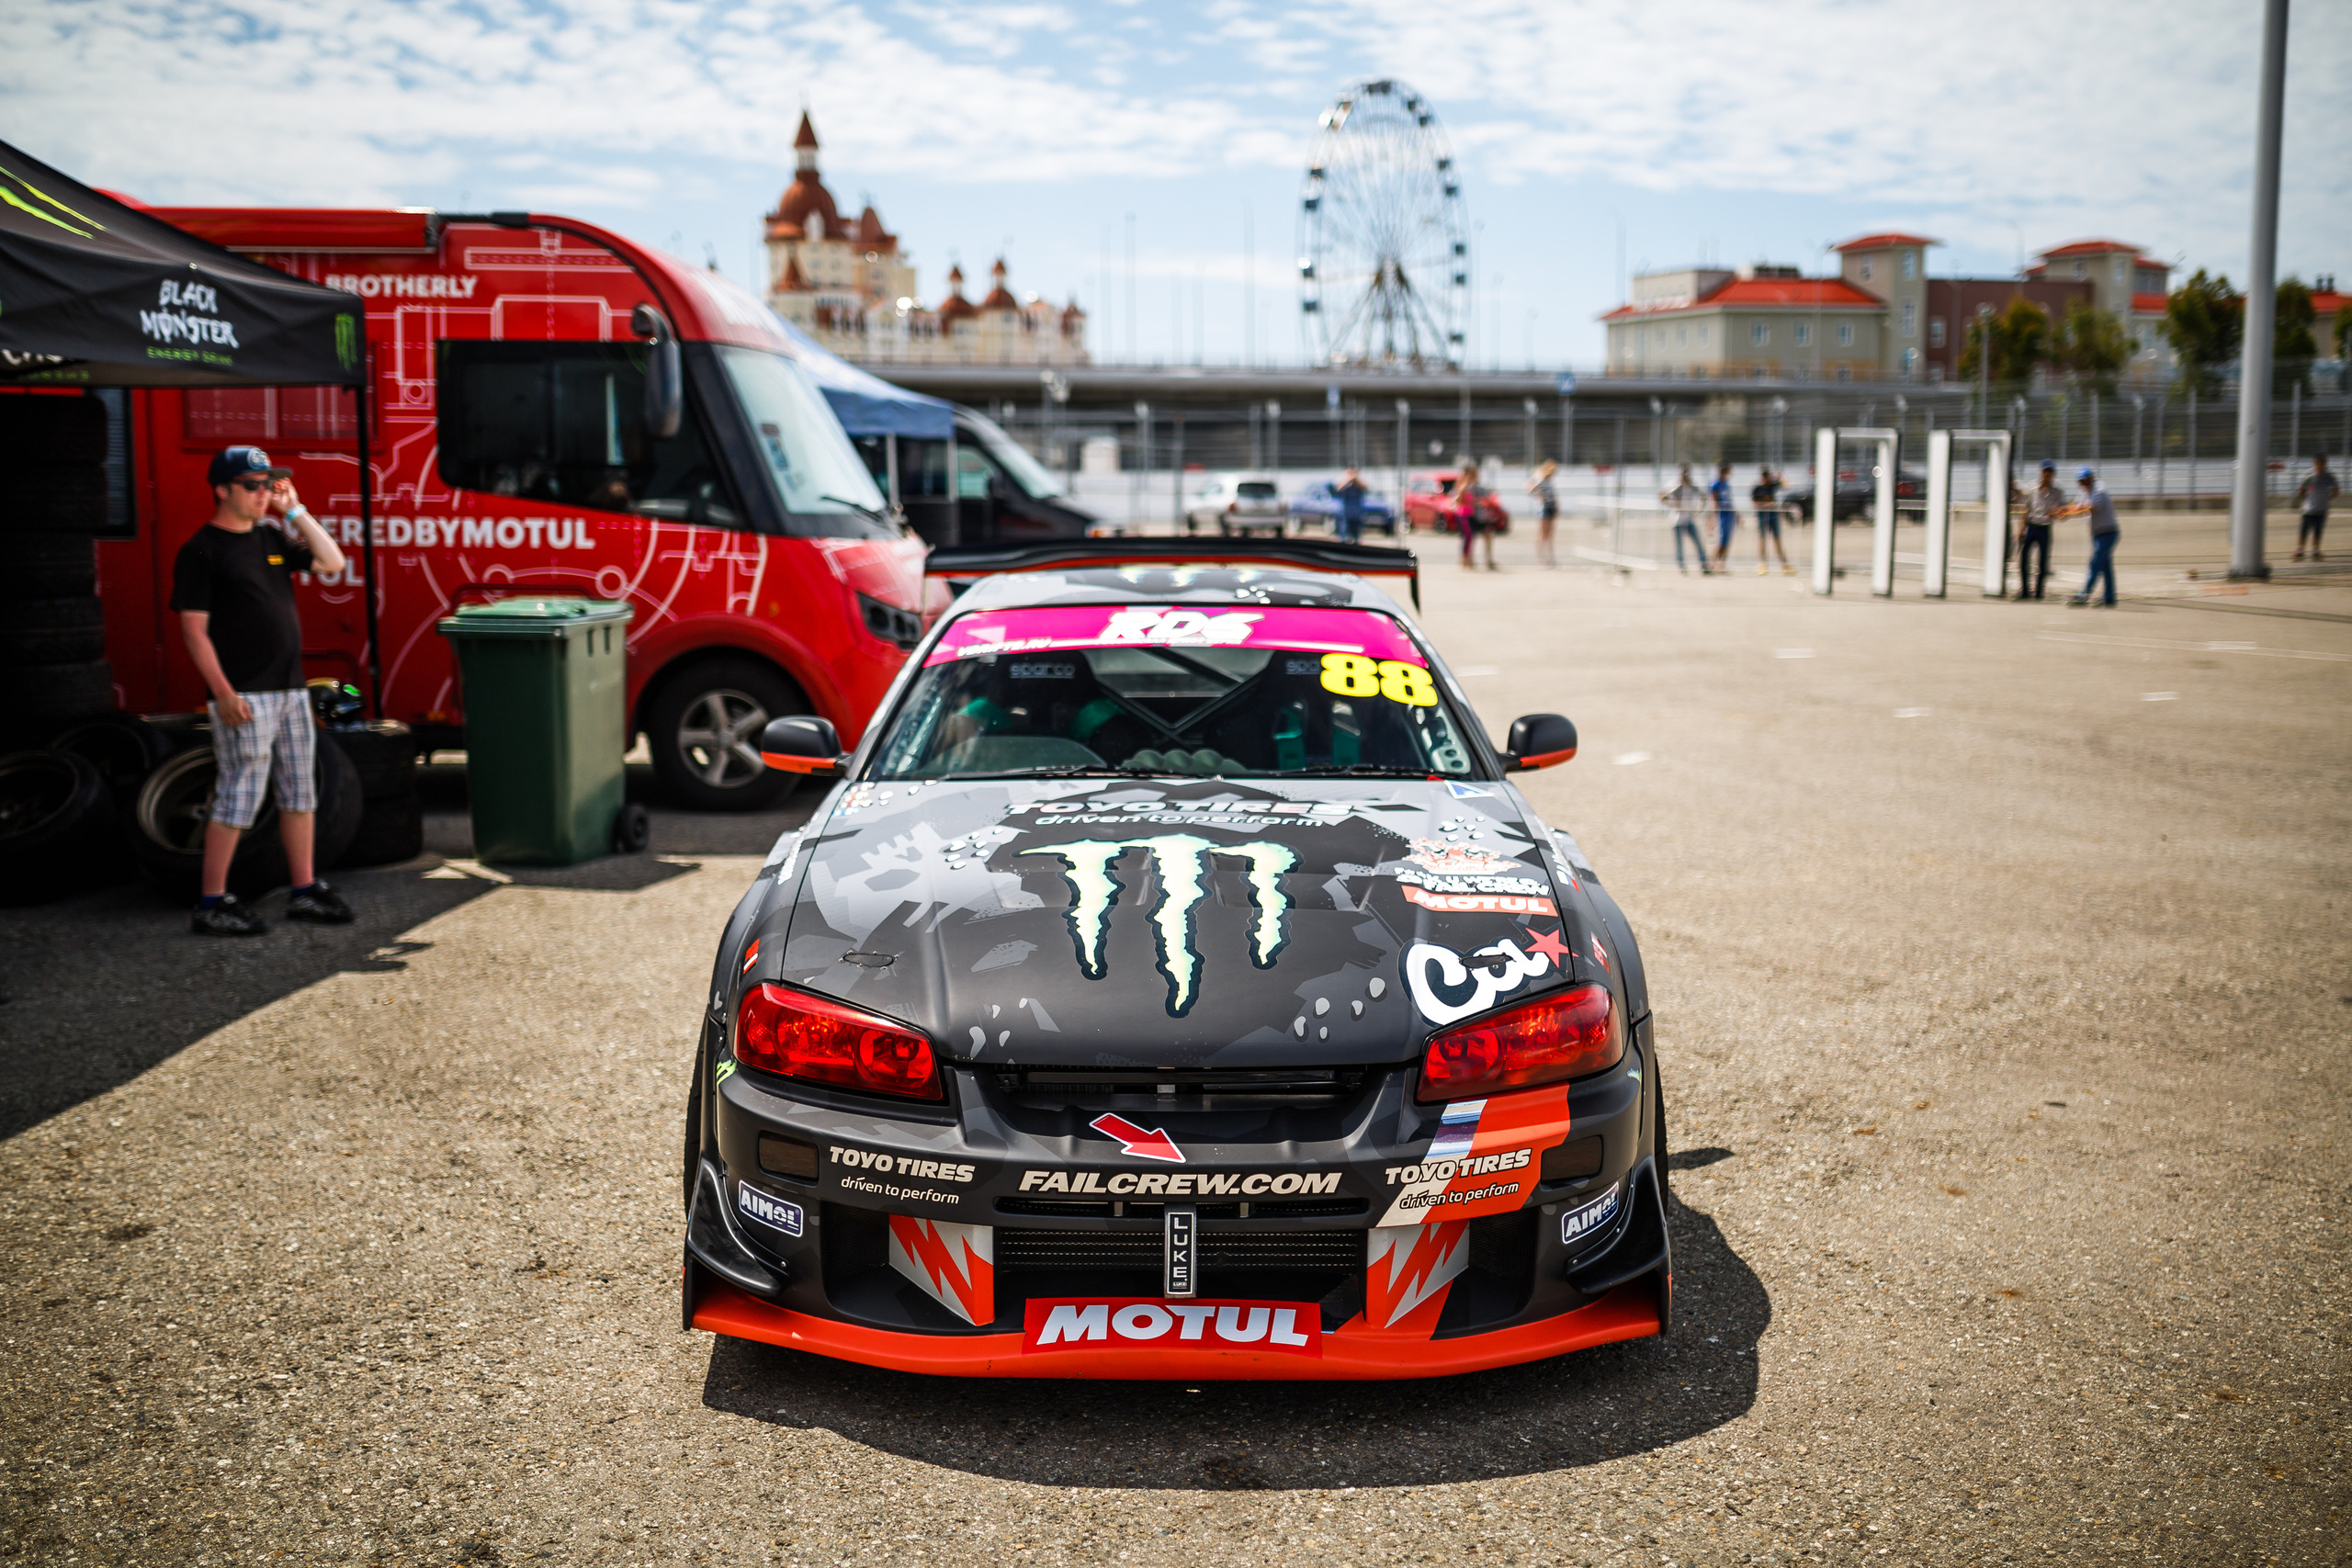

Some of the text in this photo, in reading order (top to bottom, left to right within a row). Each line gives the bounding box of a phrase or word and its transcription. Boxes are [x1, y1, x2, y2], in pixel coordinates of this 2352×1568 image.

[158, 278, 218, 313] BLACK
[324, 274, 478, 299] BROTHERLY
[139, 306, 240, 349] MONSTER
[1011, 662, 1075, 678] sparco
[1285, 659, 1320, 675] spa
[1319, 652, 1439, 707] 88
[1008, 800, 1353, 817] TOYO TIRES
[1035, 813, 1324, 828] driven to perform
[1413, 889, 1549, 914] MOTUL
[830, 1145, 976, 1183] TOYO TIRES
[1384, 1147, 1532, 1186] TOYO TIRES
[841, 1176, 960, 1205] driven to perform
[1018, 1170, 1342, 1195] FAILCREW.COM
[1398, 1181, 1520, 1210] driven to perform
[741, 1189, 799, 1231] AIMOL
[1172, 1216, 1189, 1279] LUKE
[1035, 1303, 1309, 1347] MOTUL
